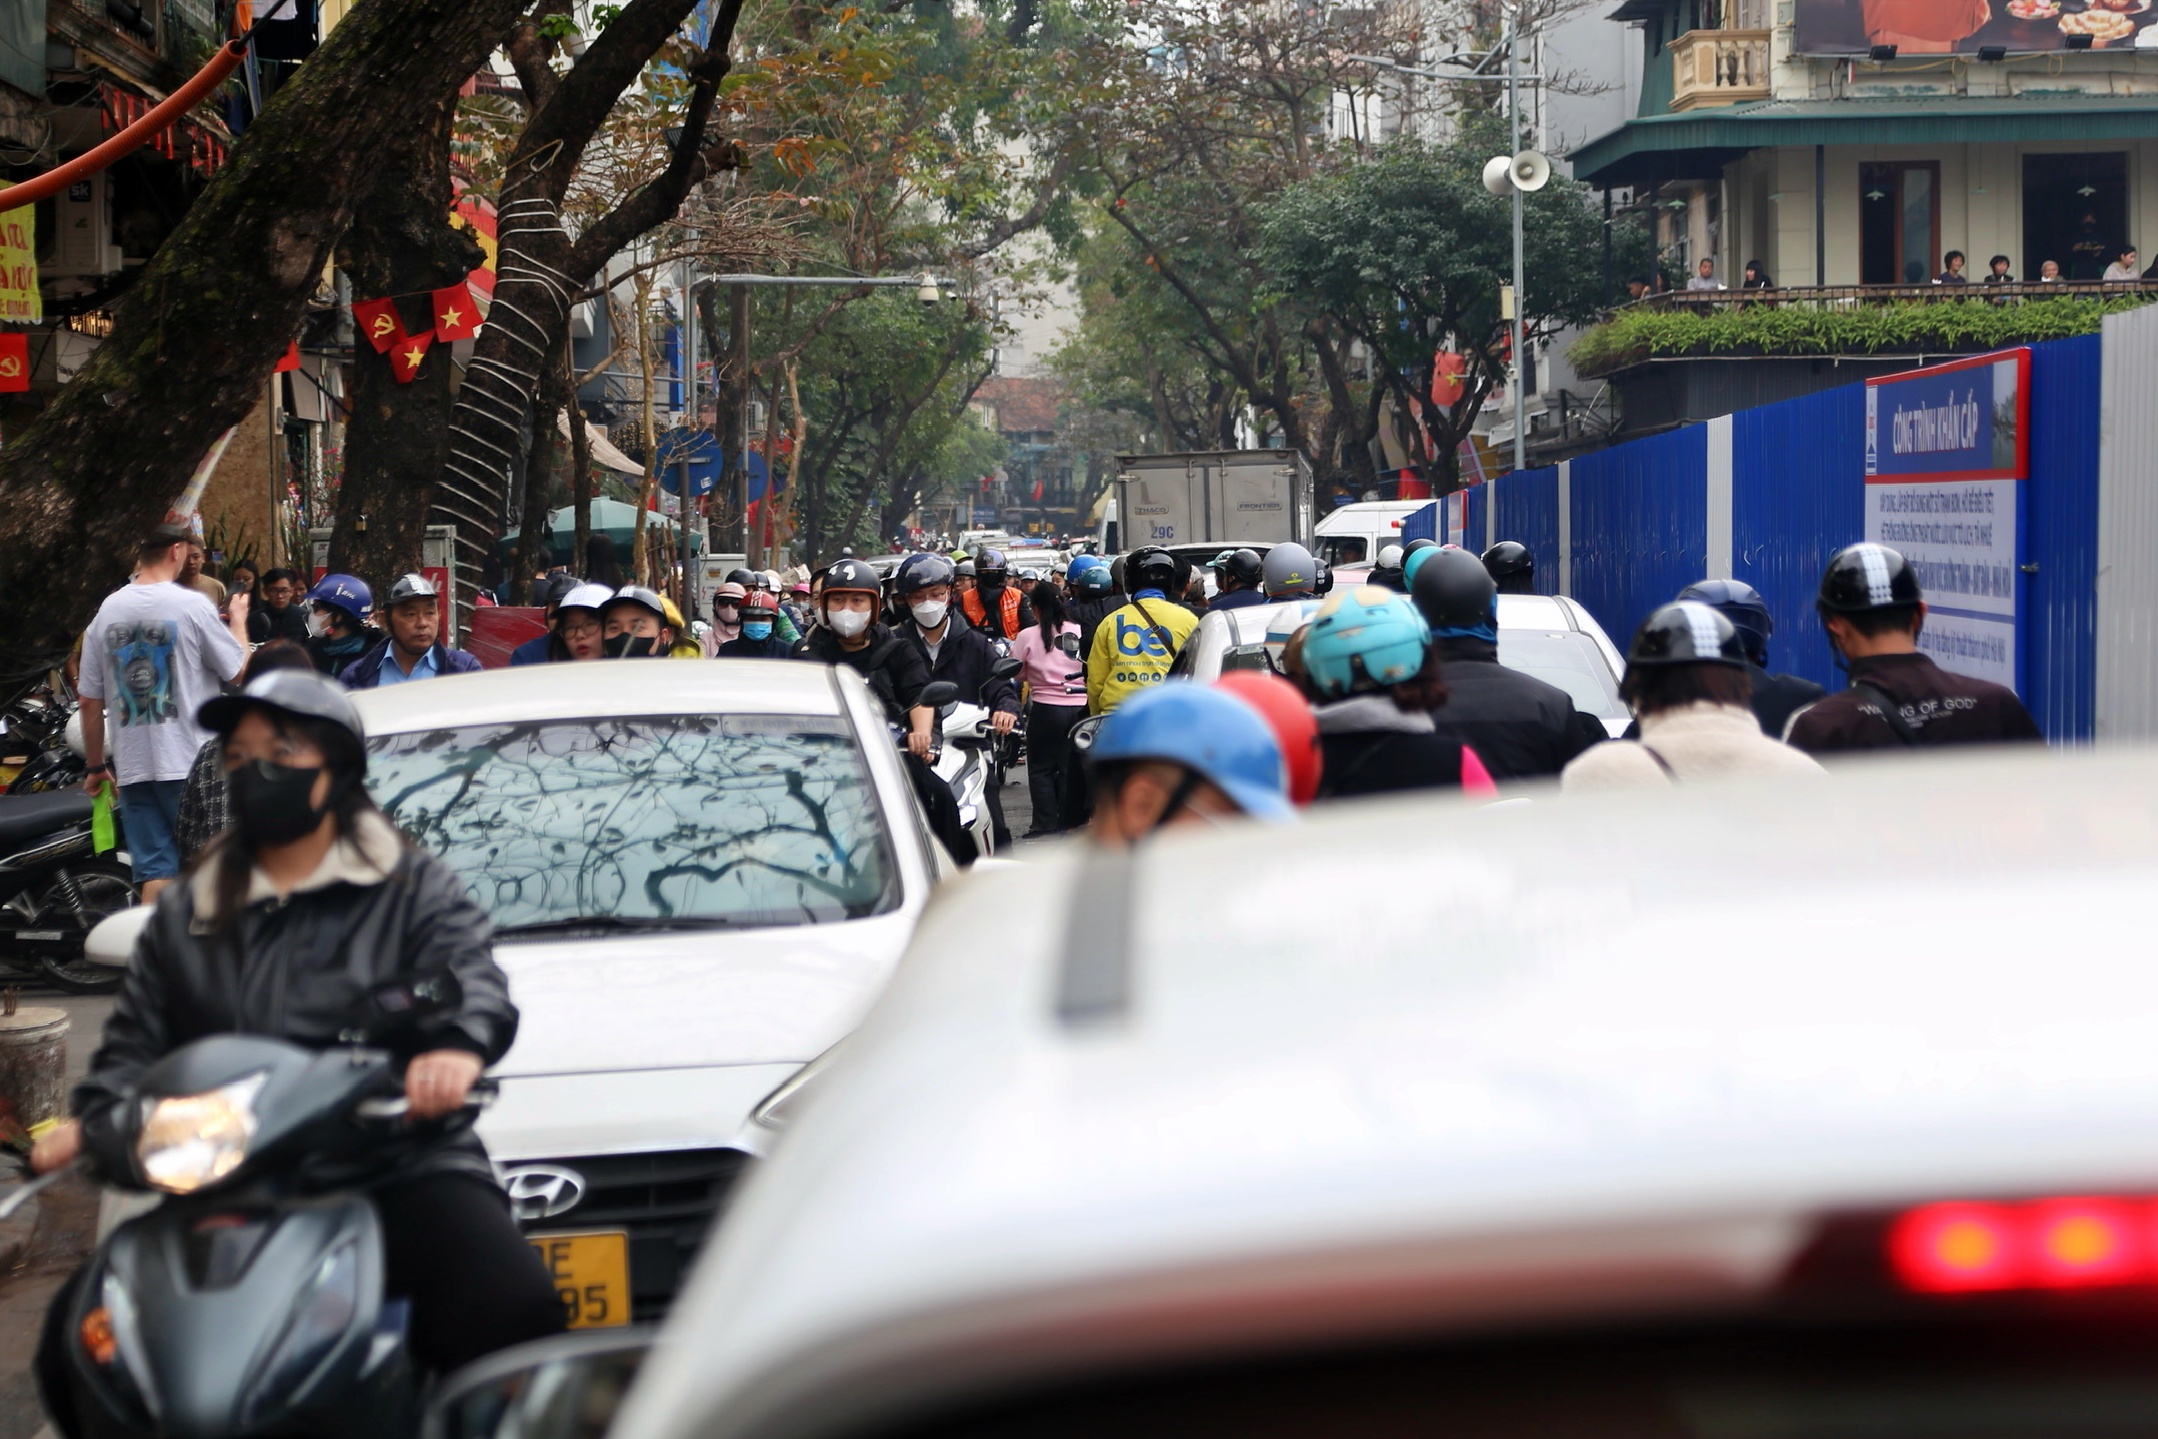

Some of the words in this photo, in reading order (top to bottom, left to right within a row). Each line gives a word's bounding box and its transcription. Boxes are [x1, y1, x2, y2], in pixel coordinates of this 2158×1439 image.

[1893, 404, 1913, 454] CÔNG
[1913, 400, 1936, 453] TRÌNH
[1151, 526, 1174, 539] 29C
[1116, 614, 1174, 657] be
[1920, 700, 1939, 714] OF
